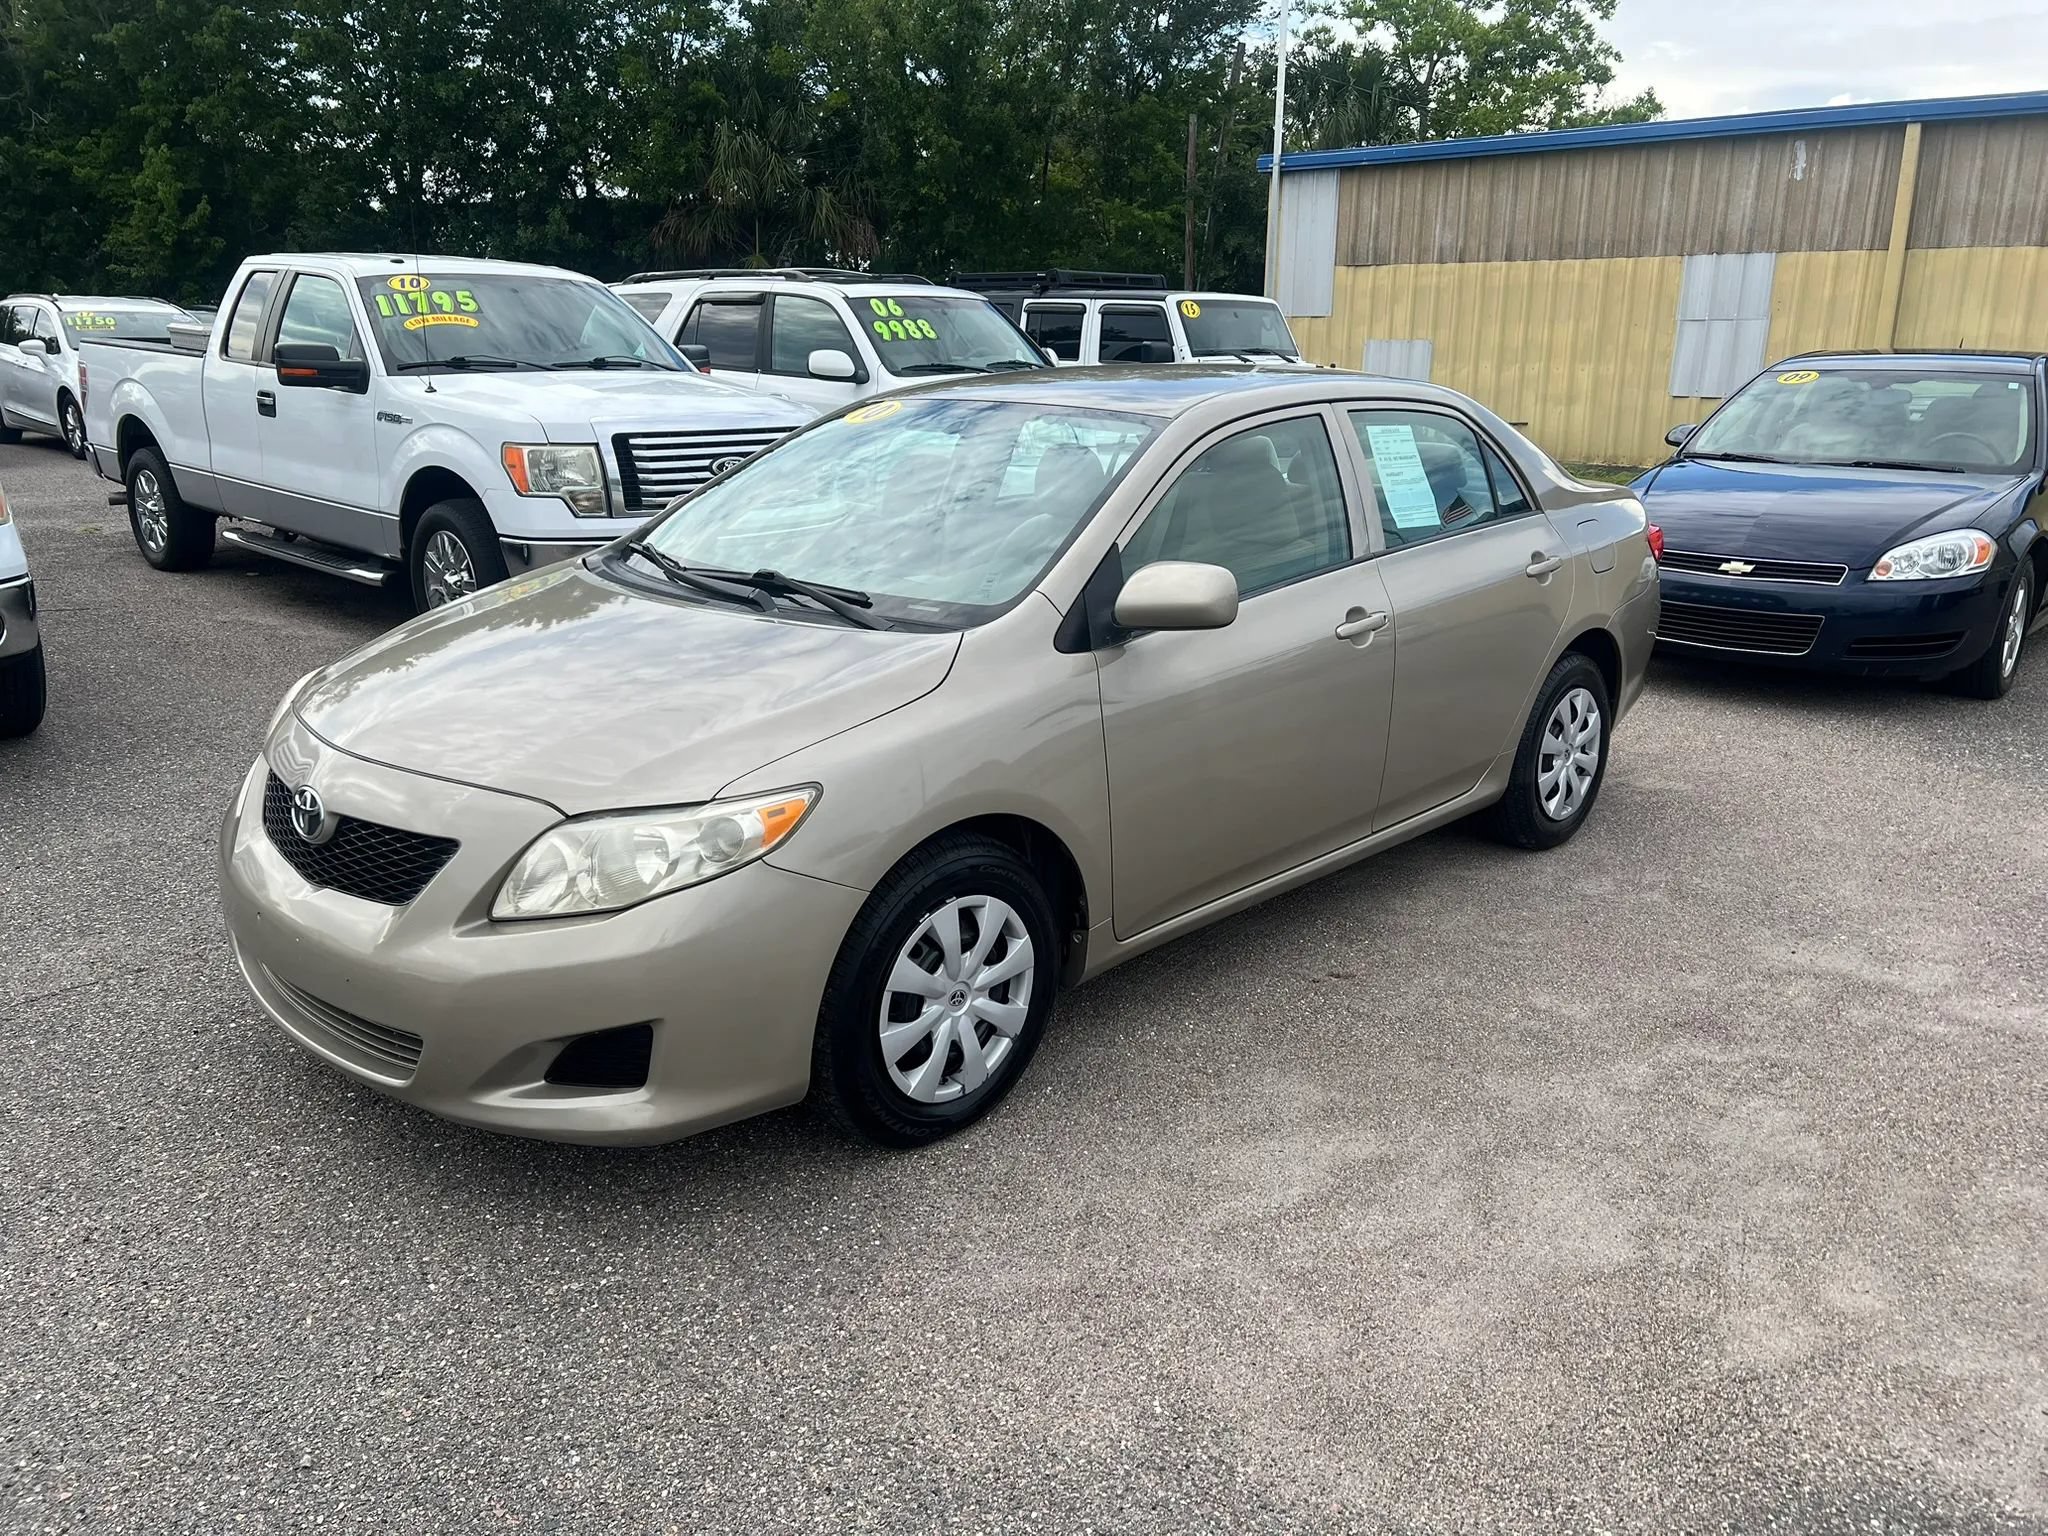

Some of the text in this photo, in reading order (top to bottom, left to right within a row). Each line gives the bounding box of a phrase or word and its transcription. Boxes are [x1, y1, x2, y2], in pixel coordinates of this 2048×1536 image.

[399, 278, 420, 289] 10
[375, 291, 480, 317] 11795
[869, 298, 905, 318] 06
[1185, 303, 1196, 315] 15
[65, 315, 117, 327] 11750
[408, 315, 471, 327] LOW MILEAGE
[873, 319, 938, 341] 9988
[1783, 373, 1811, 381] 09
